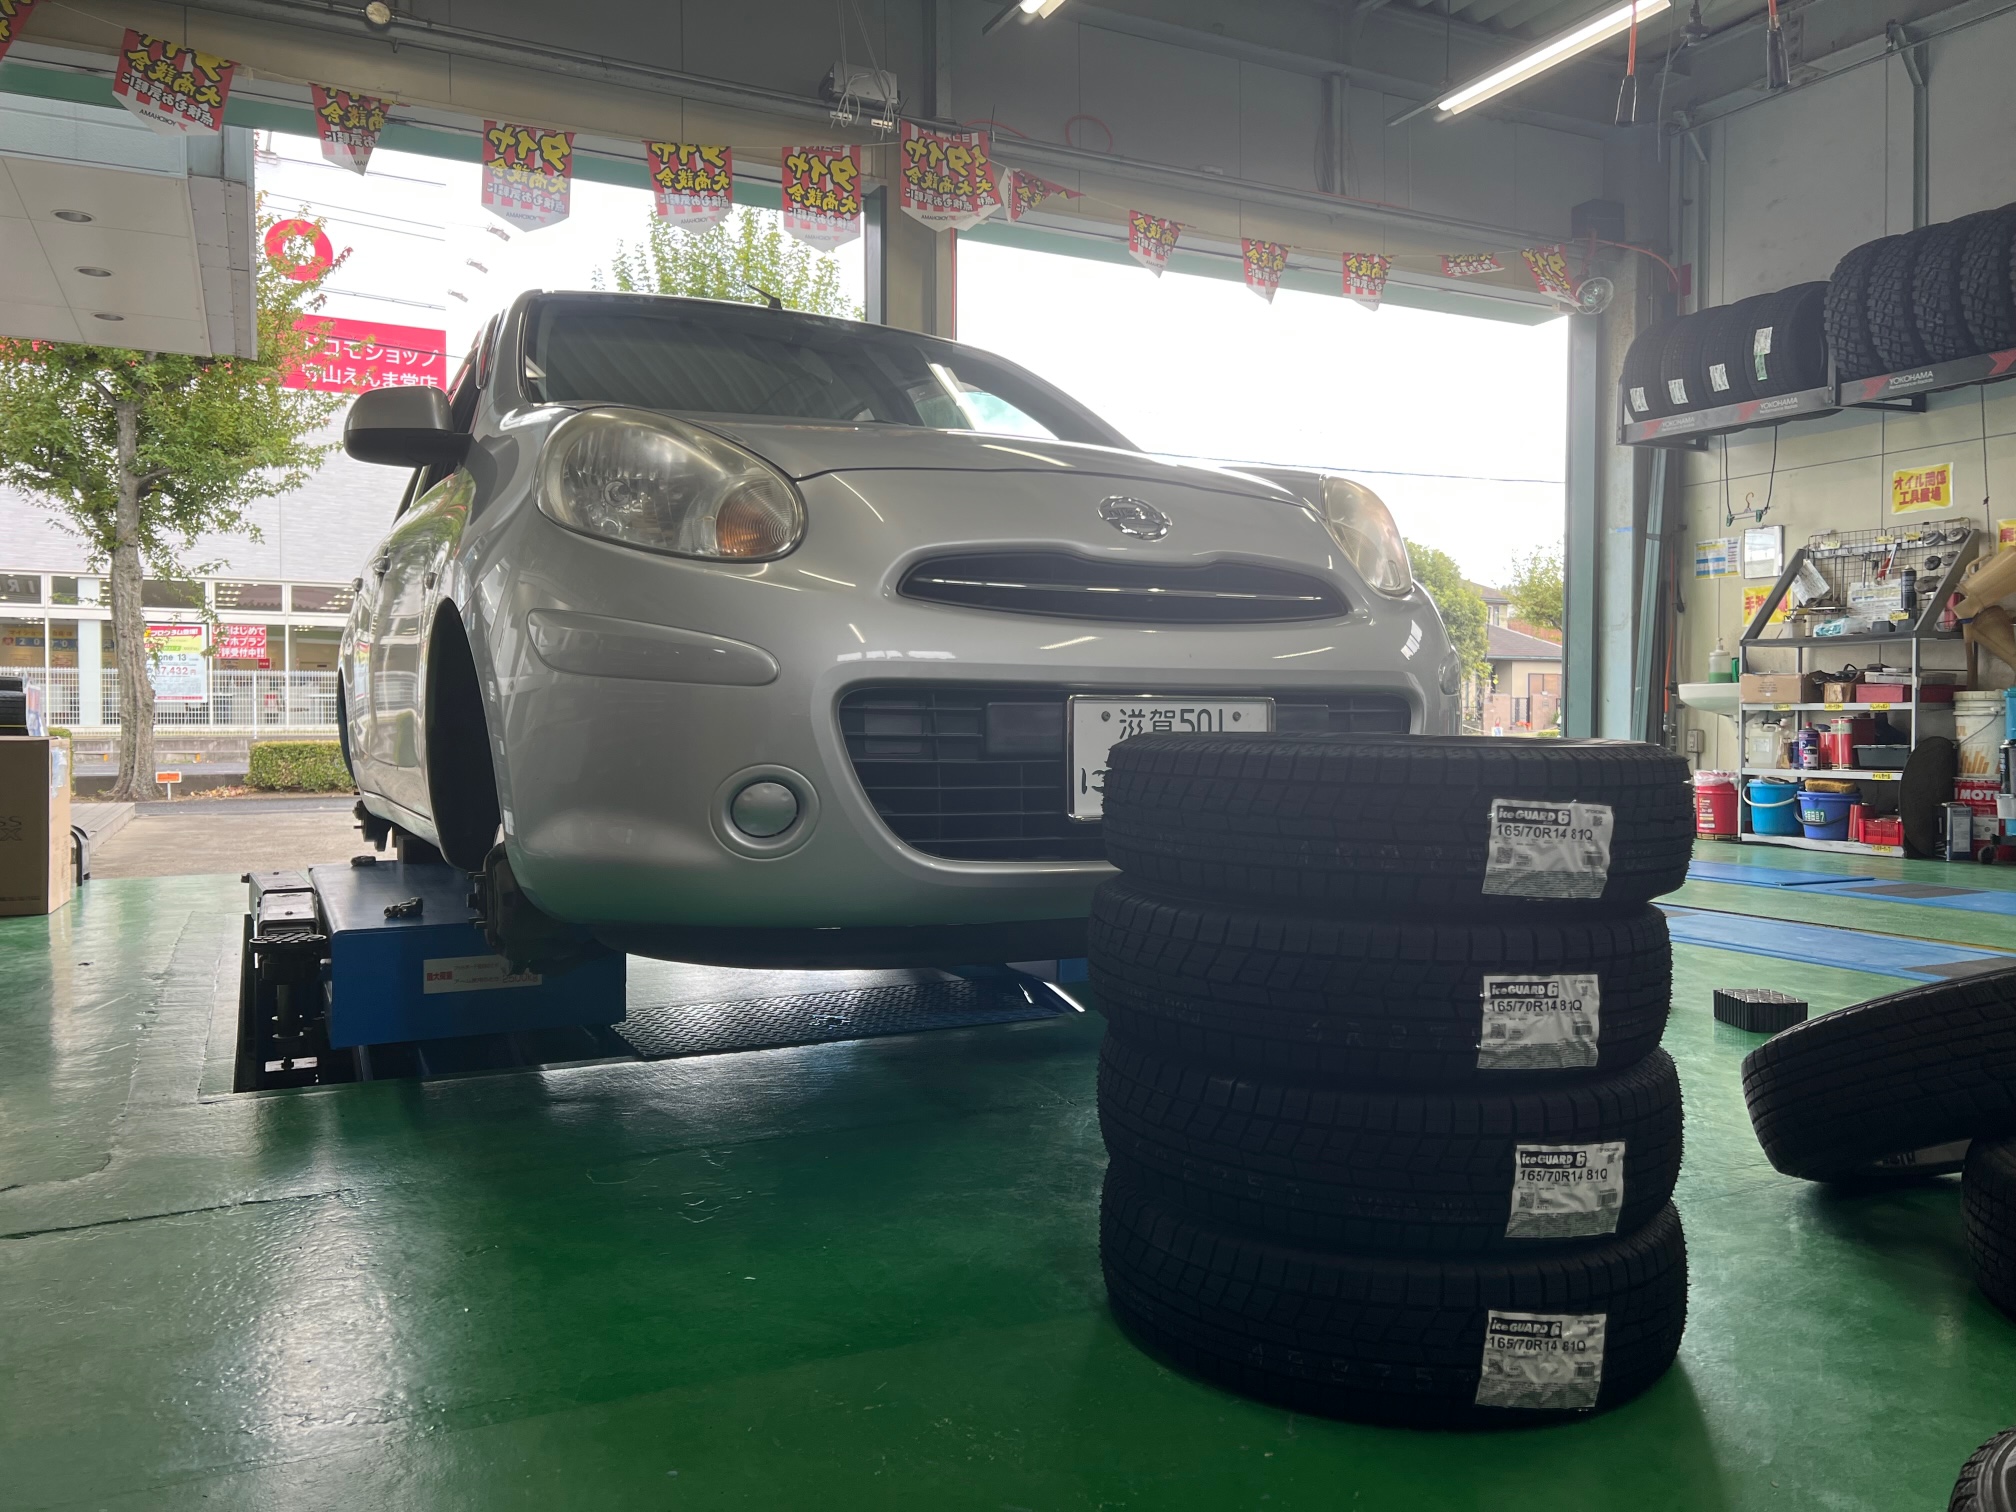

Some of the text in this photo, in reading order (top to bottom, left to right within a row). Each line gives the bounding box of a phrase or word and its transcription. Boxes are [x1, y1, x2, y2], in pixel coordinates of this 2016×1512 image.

[1889, 371, 1934, 385] YOKOHAMA
[1760, 397, 1799, 409] YOKOHAMA
[1496, 824, 1593, 841] 165/70R14 81Q
[1489, 999, 1583, 1012] 165/70R14 81Q
[1519, 1168, 1608, 1182] 165/70R14 81Q
[1489, 1335, 1586, 1352] 165/70R14 81Q
